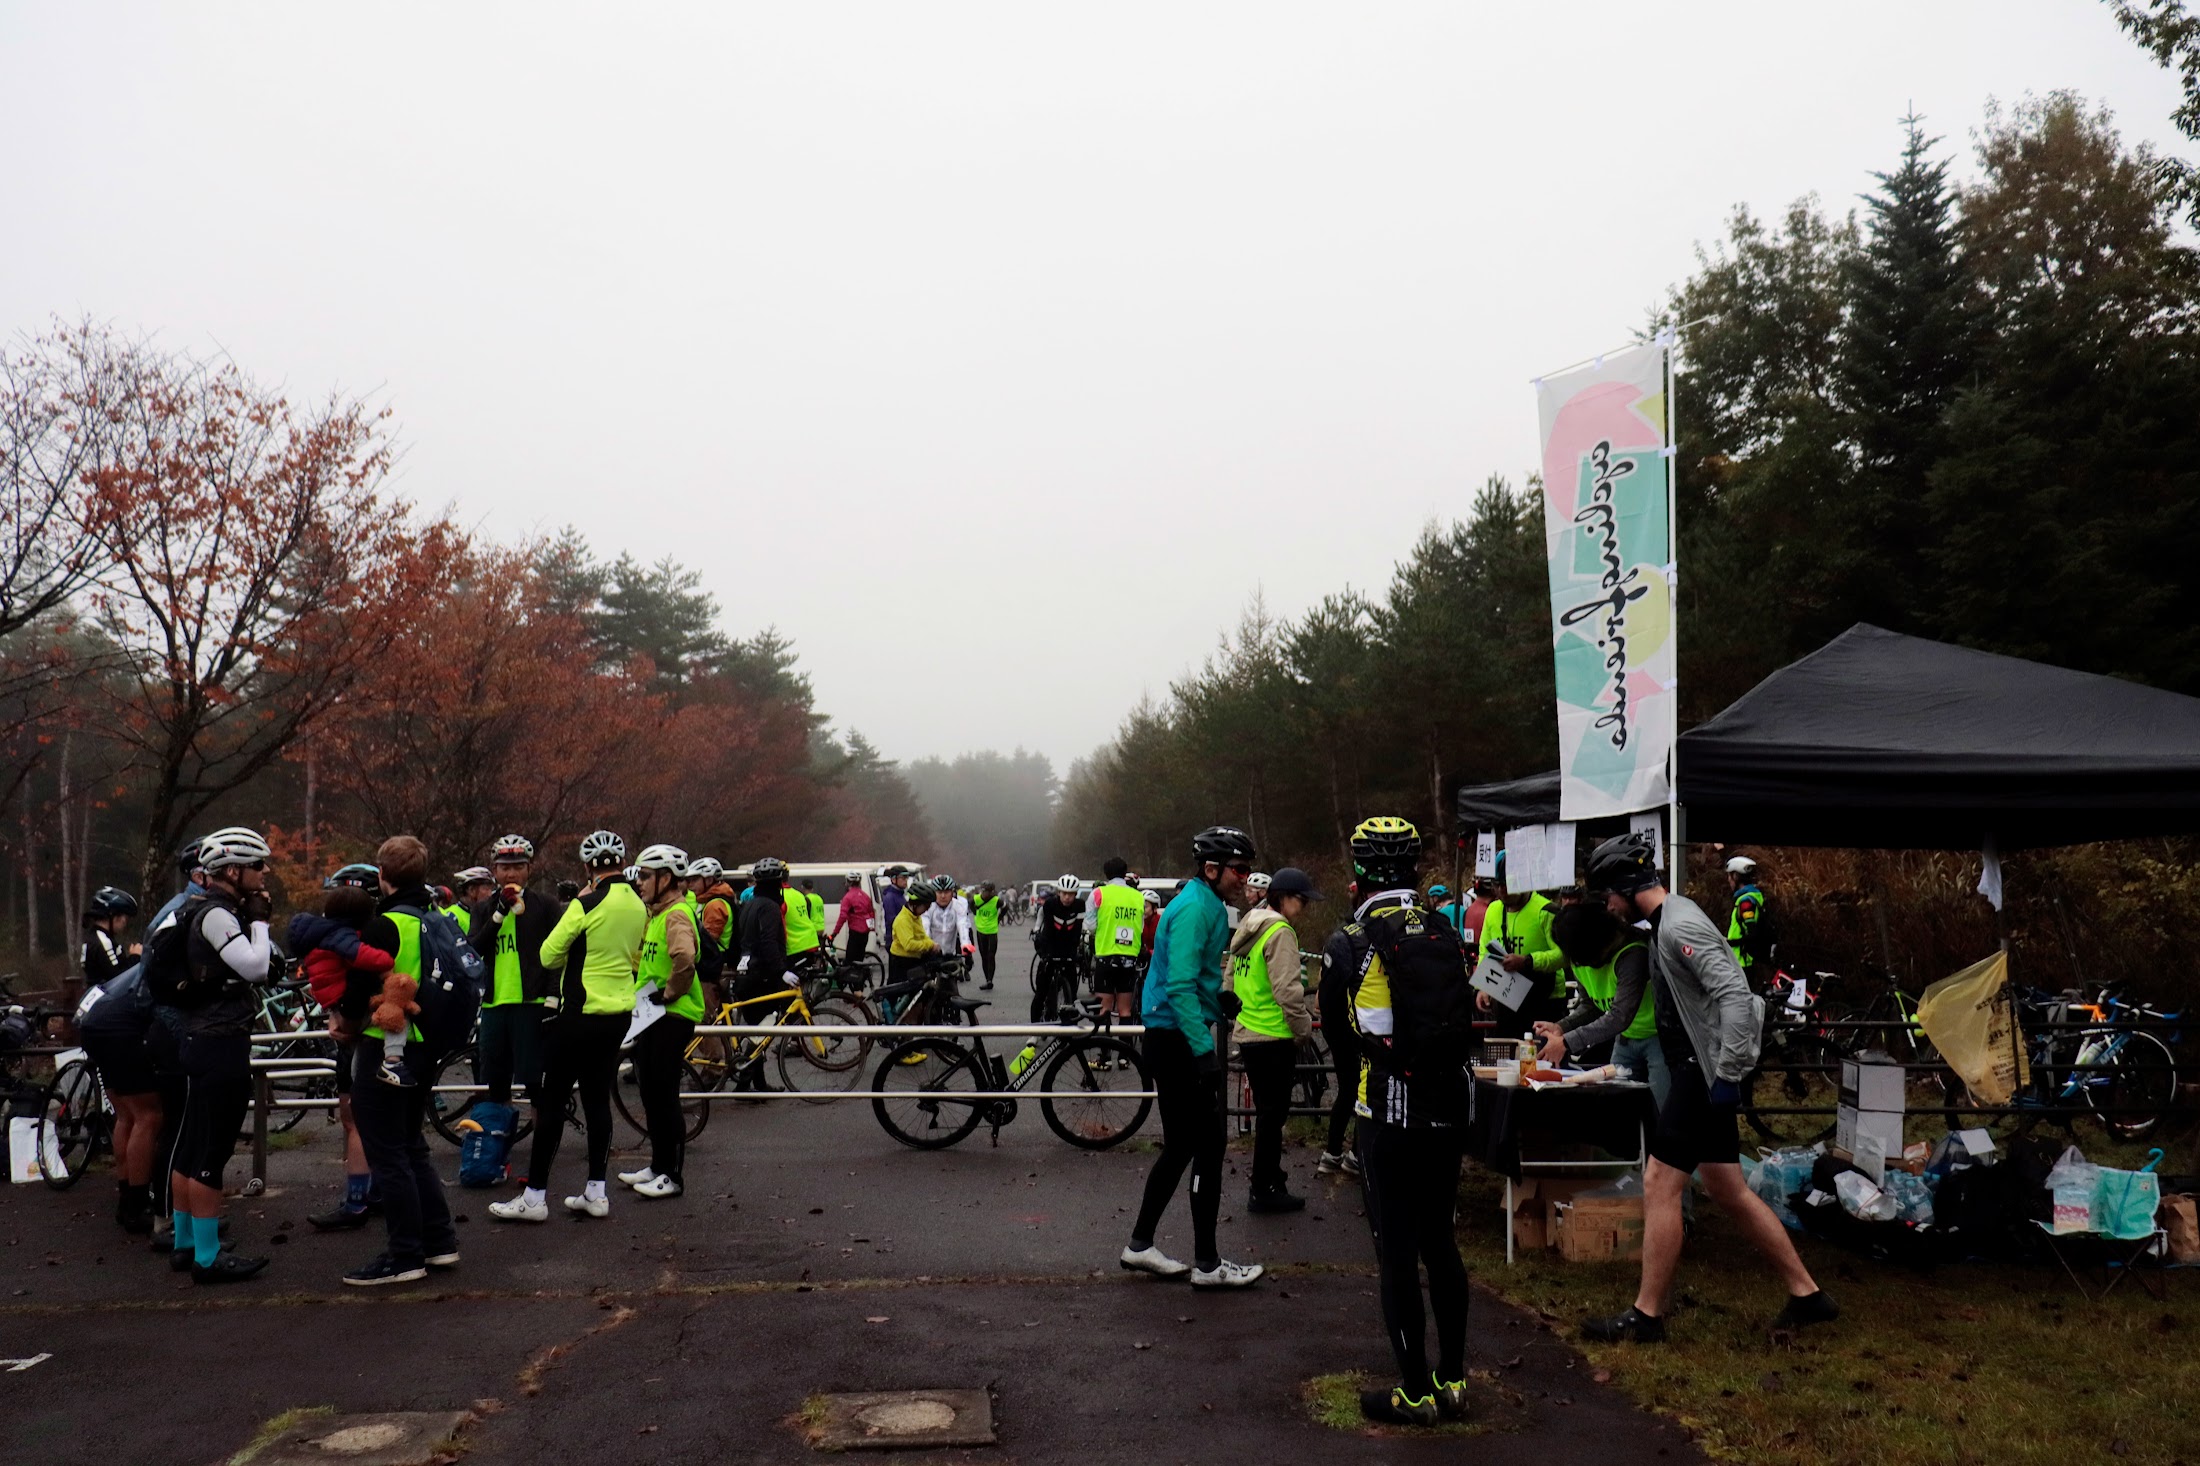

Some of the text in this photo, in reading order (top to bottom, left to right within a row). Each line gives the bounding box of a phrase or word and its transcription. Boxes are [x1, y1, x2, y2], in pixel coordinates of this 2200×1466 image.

[1478, 843, 1491, 864] 受付
[1115, 906, 1137, 921] STAFF
[495, 933, 517, 955] STA
[1485, 968, 1503, 985] 11
[1013, 1039, 1062, 1091] BRIDGESTONE
